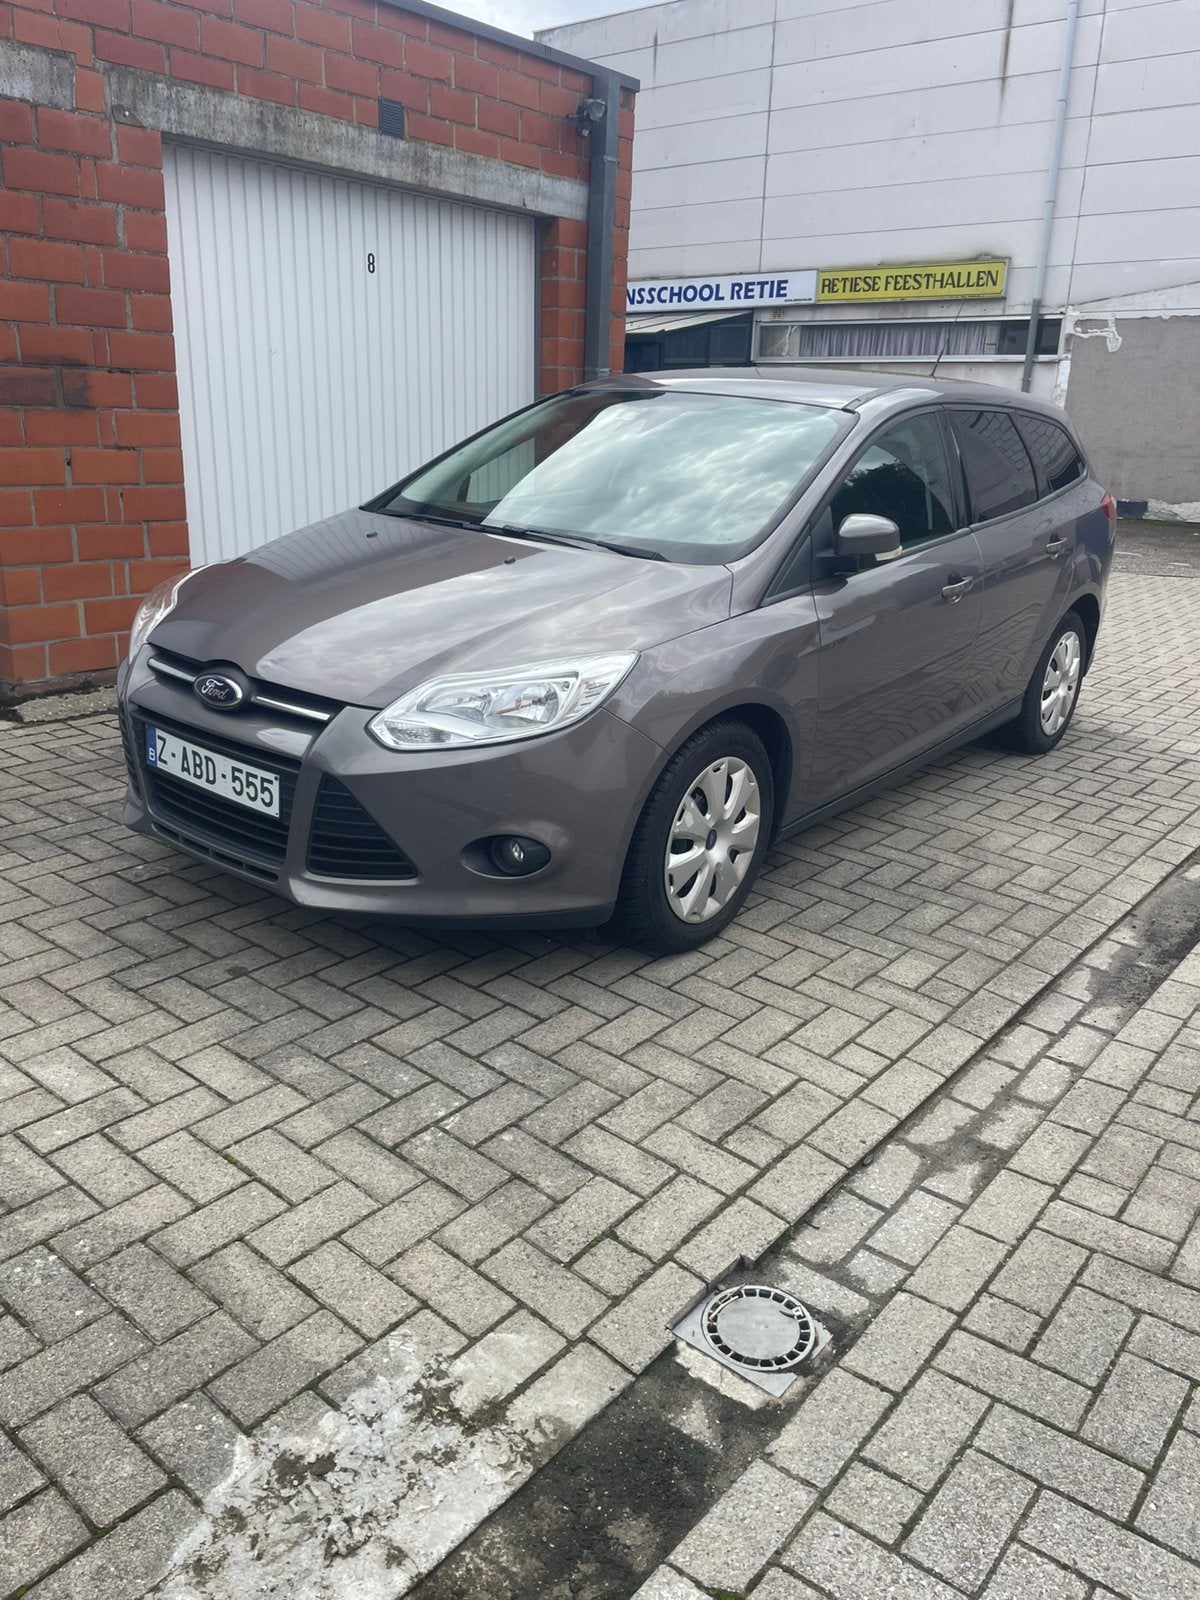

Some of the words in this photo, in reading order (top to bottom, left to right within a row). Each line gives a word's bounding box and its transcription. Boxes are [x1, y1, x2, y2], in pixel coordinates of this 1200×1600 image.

[367, 253, 376, 274] 8
[730, 279, 789, 300] RETIE
[821, 276, 882, 294] RETIESE
[884, 270, 999, 292] FEESTHALLEN
[201, 678, 230, 701] Ford
[148, 747, 156, 762] B
[157, 734, 275, 808] Z-ABD-555
